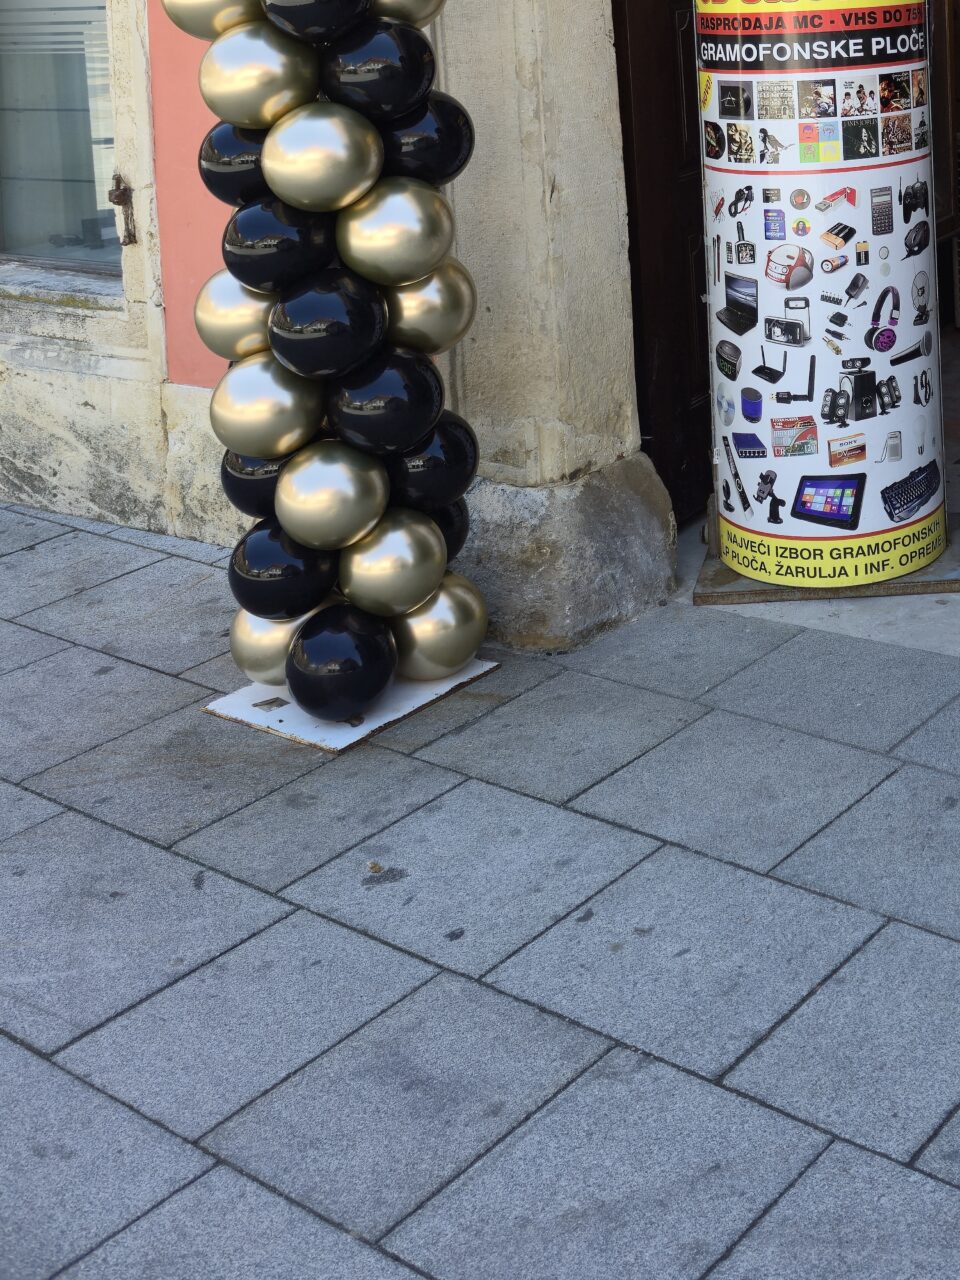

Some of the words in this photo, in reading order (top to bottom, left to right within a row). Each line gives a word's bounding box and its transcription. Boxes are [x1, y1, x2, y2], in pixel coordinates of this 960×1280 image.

[701, 15, 787, 32] RASPRODAJA
[793, 14, 823, 30] MC
[841, 11, 878, 27] VHS
[883, 9, 902, 24] DO
[701, 38, 865, 63] GRAMOFONSKE
[871, 27, 925, 56] PLOČE
[727, 530, 771, 557] NAJVEĆI
[775, 546, 824, 561] IZBOR
[829, 519, 941, 560] GRAMOFONSKIH
[731, 552, 772, 576] PLOČA,
[775, 561, 849, 579] ŽARULJA
[854, 566, 859, 577] I
[864, 560, 894, 576] INF.
